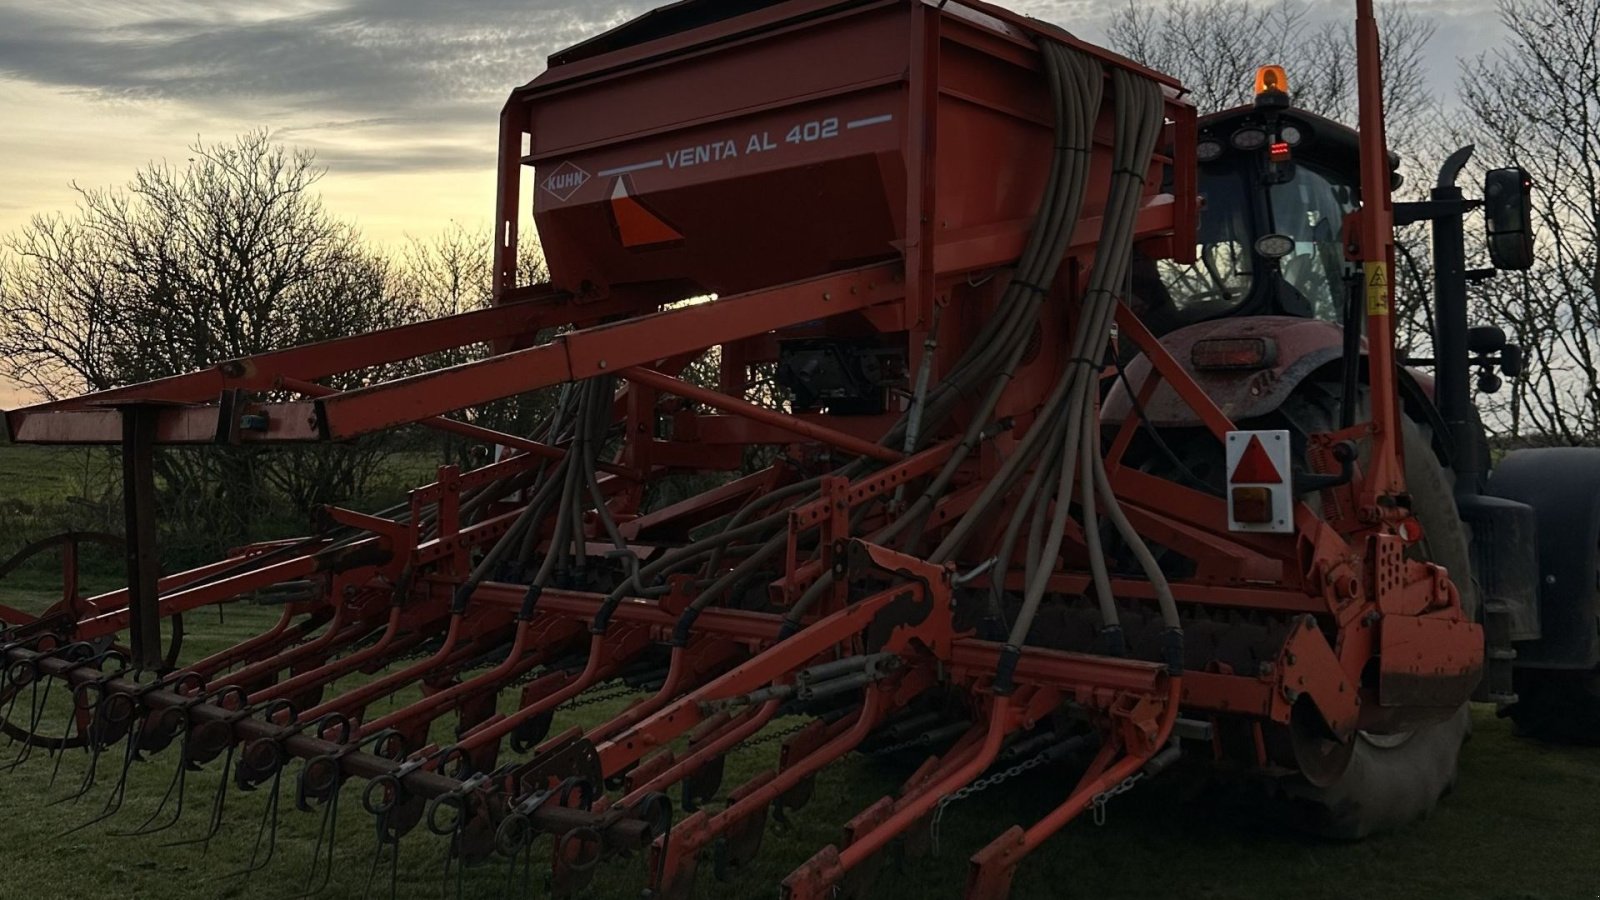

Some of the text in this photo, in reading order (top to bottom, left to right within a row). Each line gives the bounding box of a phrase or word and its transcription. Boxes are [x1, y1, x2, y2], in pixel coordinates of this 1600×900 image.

[666, 117, 839, 169] VENTA AL 402
[547, 172, 583, 191] KUHN
